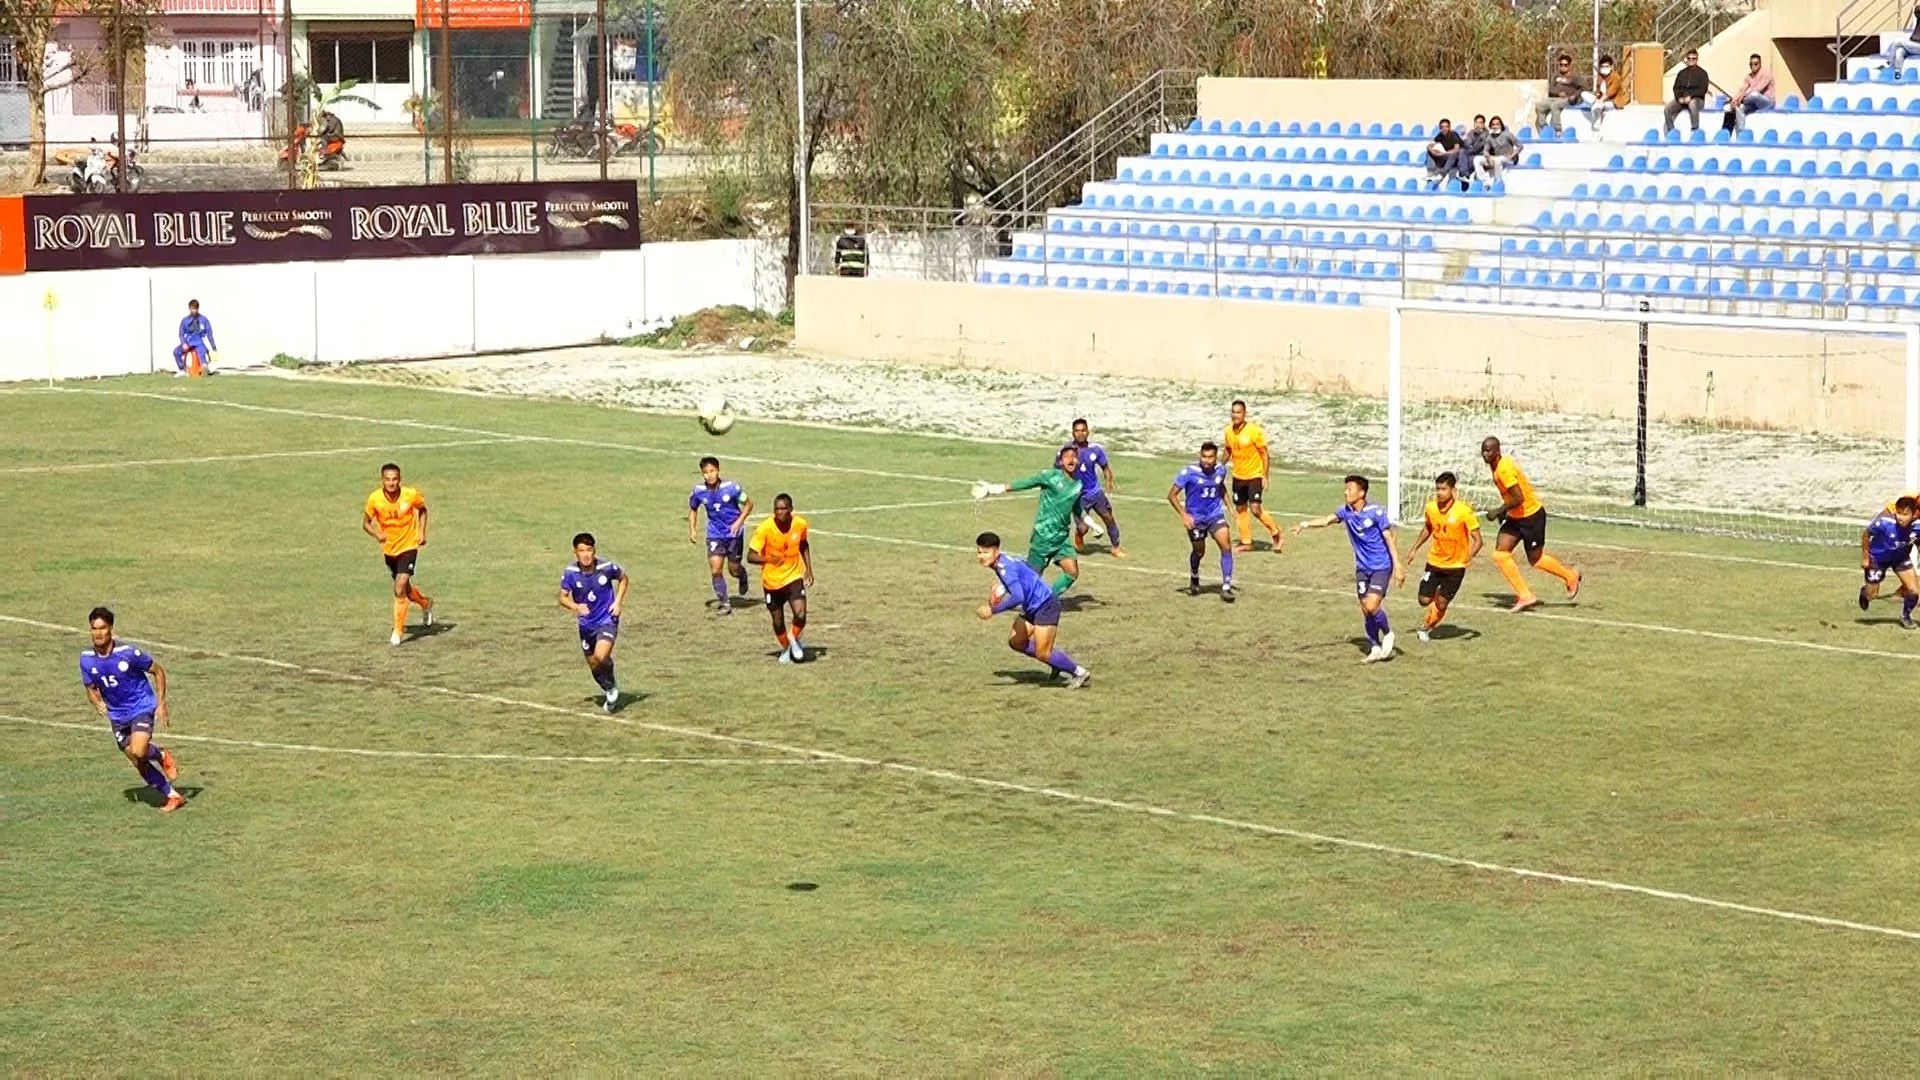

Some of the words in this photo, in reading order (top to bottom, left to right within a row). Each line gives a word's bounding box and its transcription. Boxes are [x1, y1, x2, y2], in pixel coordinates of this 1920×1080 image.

[350, 203, 456, 241] ROYAL
[462, 200, 540, 236] BLUE
[33, 212, 145, 251] ROYAL
[153, 210, 237, 247] BLUE
[710, 541, 718, 552] 7
[588, 590, 597, 602] 6
[101, 675, 118, 688] 15
